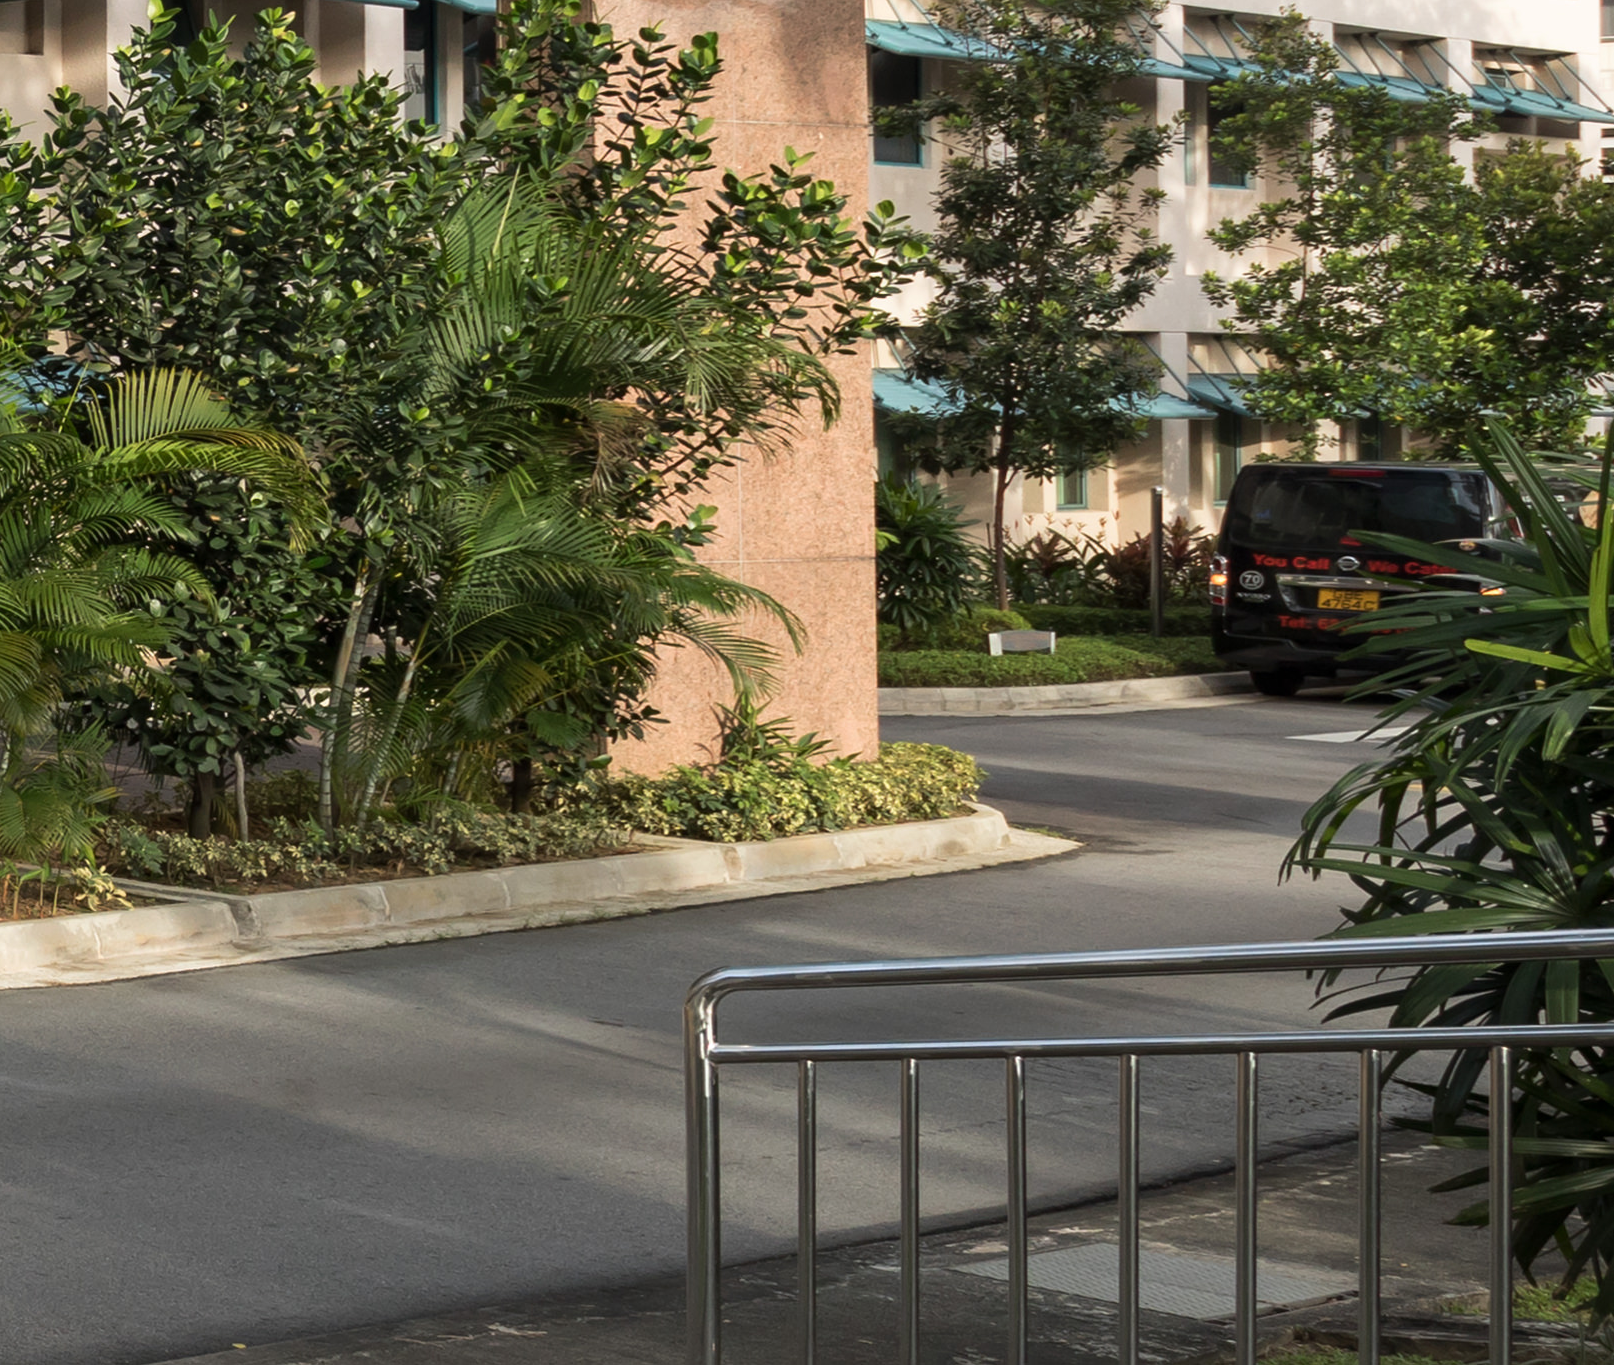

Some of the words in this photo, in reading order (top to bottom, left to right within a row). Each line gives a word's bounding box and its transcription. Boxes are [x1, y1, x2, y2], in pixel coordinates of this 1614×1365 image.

[1253, 554, 1288, 567] You
[1292, 556, 1331, 570] Call
[1367, 560, 1399, 574] We
[1244, 574, 1260, 585] 70
[1321, 598, 1375, 610] 4764C
